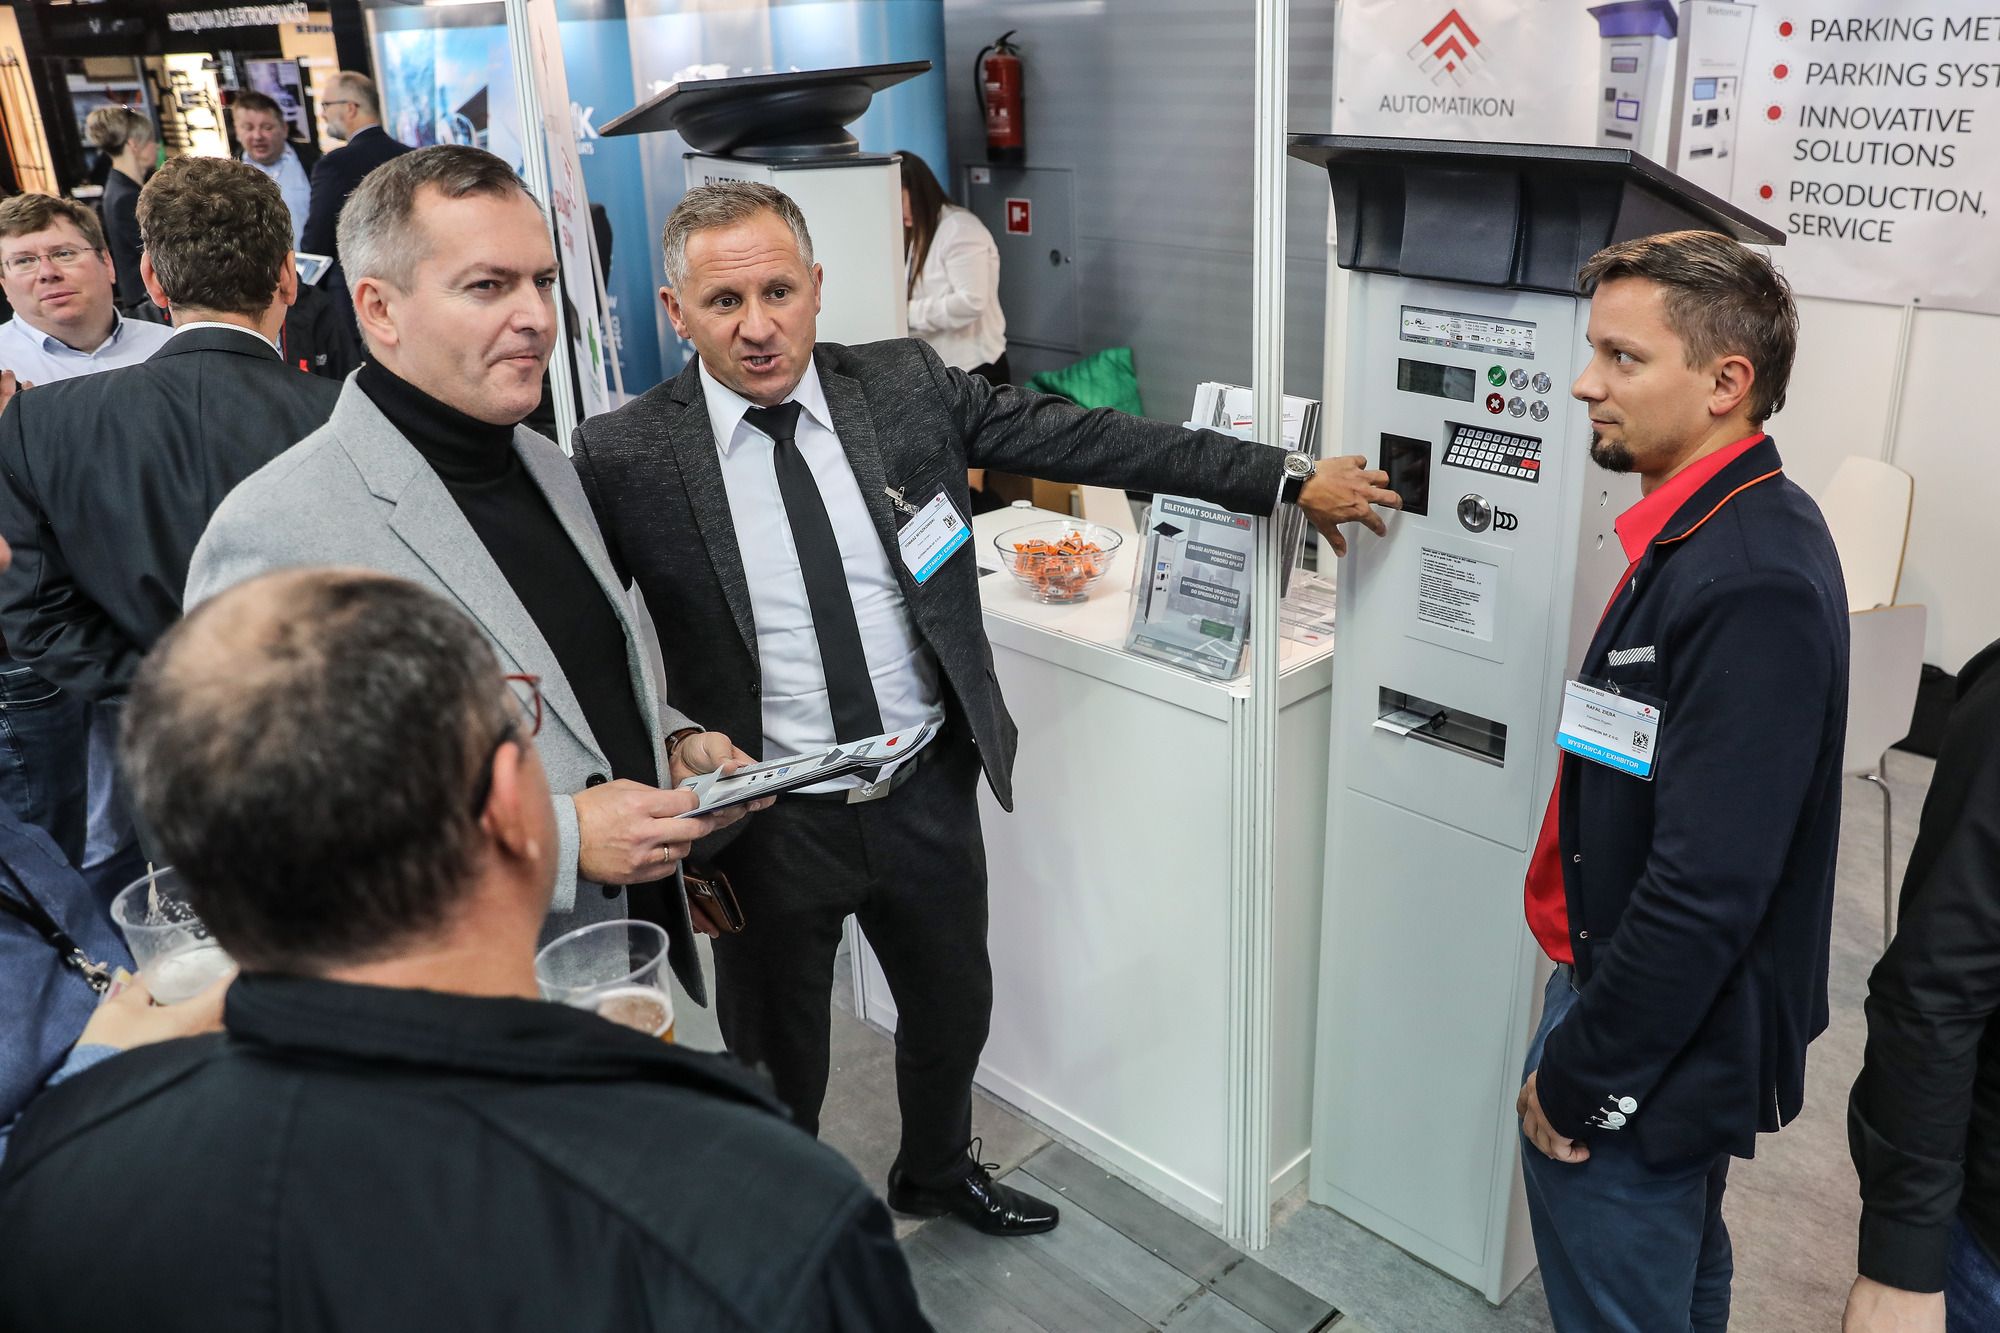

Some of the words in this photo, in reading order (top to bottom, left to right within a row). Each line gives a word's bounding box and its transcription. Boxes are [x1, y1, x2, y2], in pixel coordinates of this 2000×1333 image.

[1810, 17, 1934, 42] PARKING
[1805, 62, 1927, 87] PARKING
[1379, 95, 1515, 117] AUTOMATIKON
[1799, 105, 1975, 133] INNOVATIVE
[1793, 138, 1956, 168] SOLUTIONS
[1789, 180, 1987, 218] PRODUCTION,
[1787, 213, 1895, 243] SERVICE
[1164, 502, 1200, 516] BILETOMAT
[1200, 510, 1231, 523] SOLARNY
[1567, 738, 1602, 755] WYSTAWCA
[1605, 752, 1639, 769] EXHIBITOR
